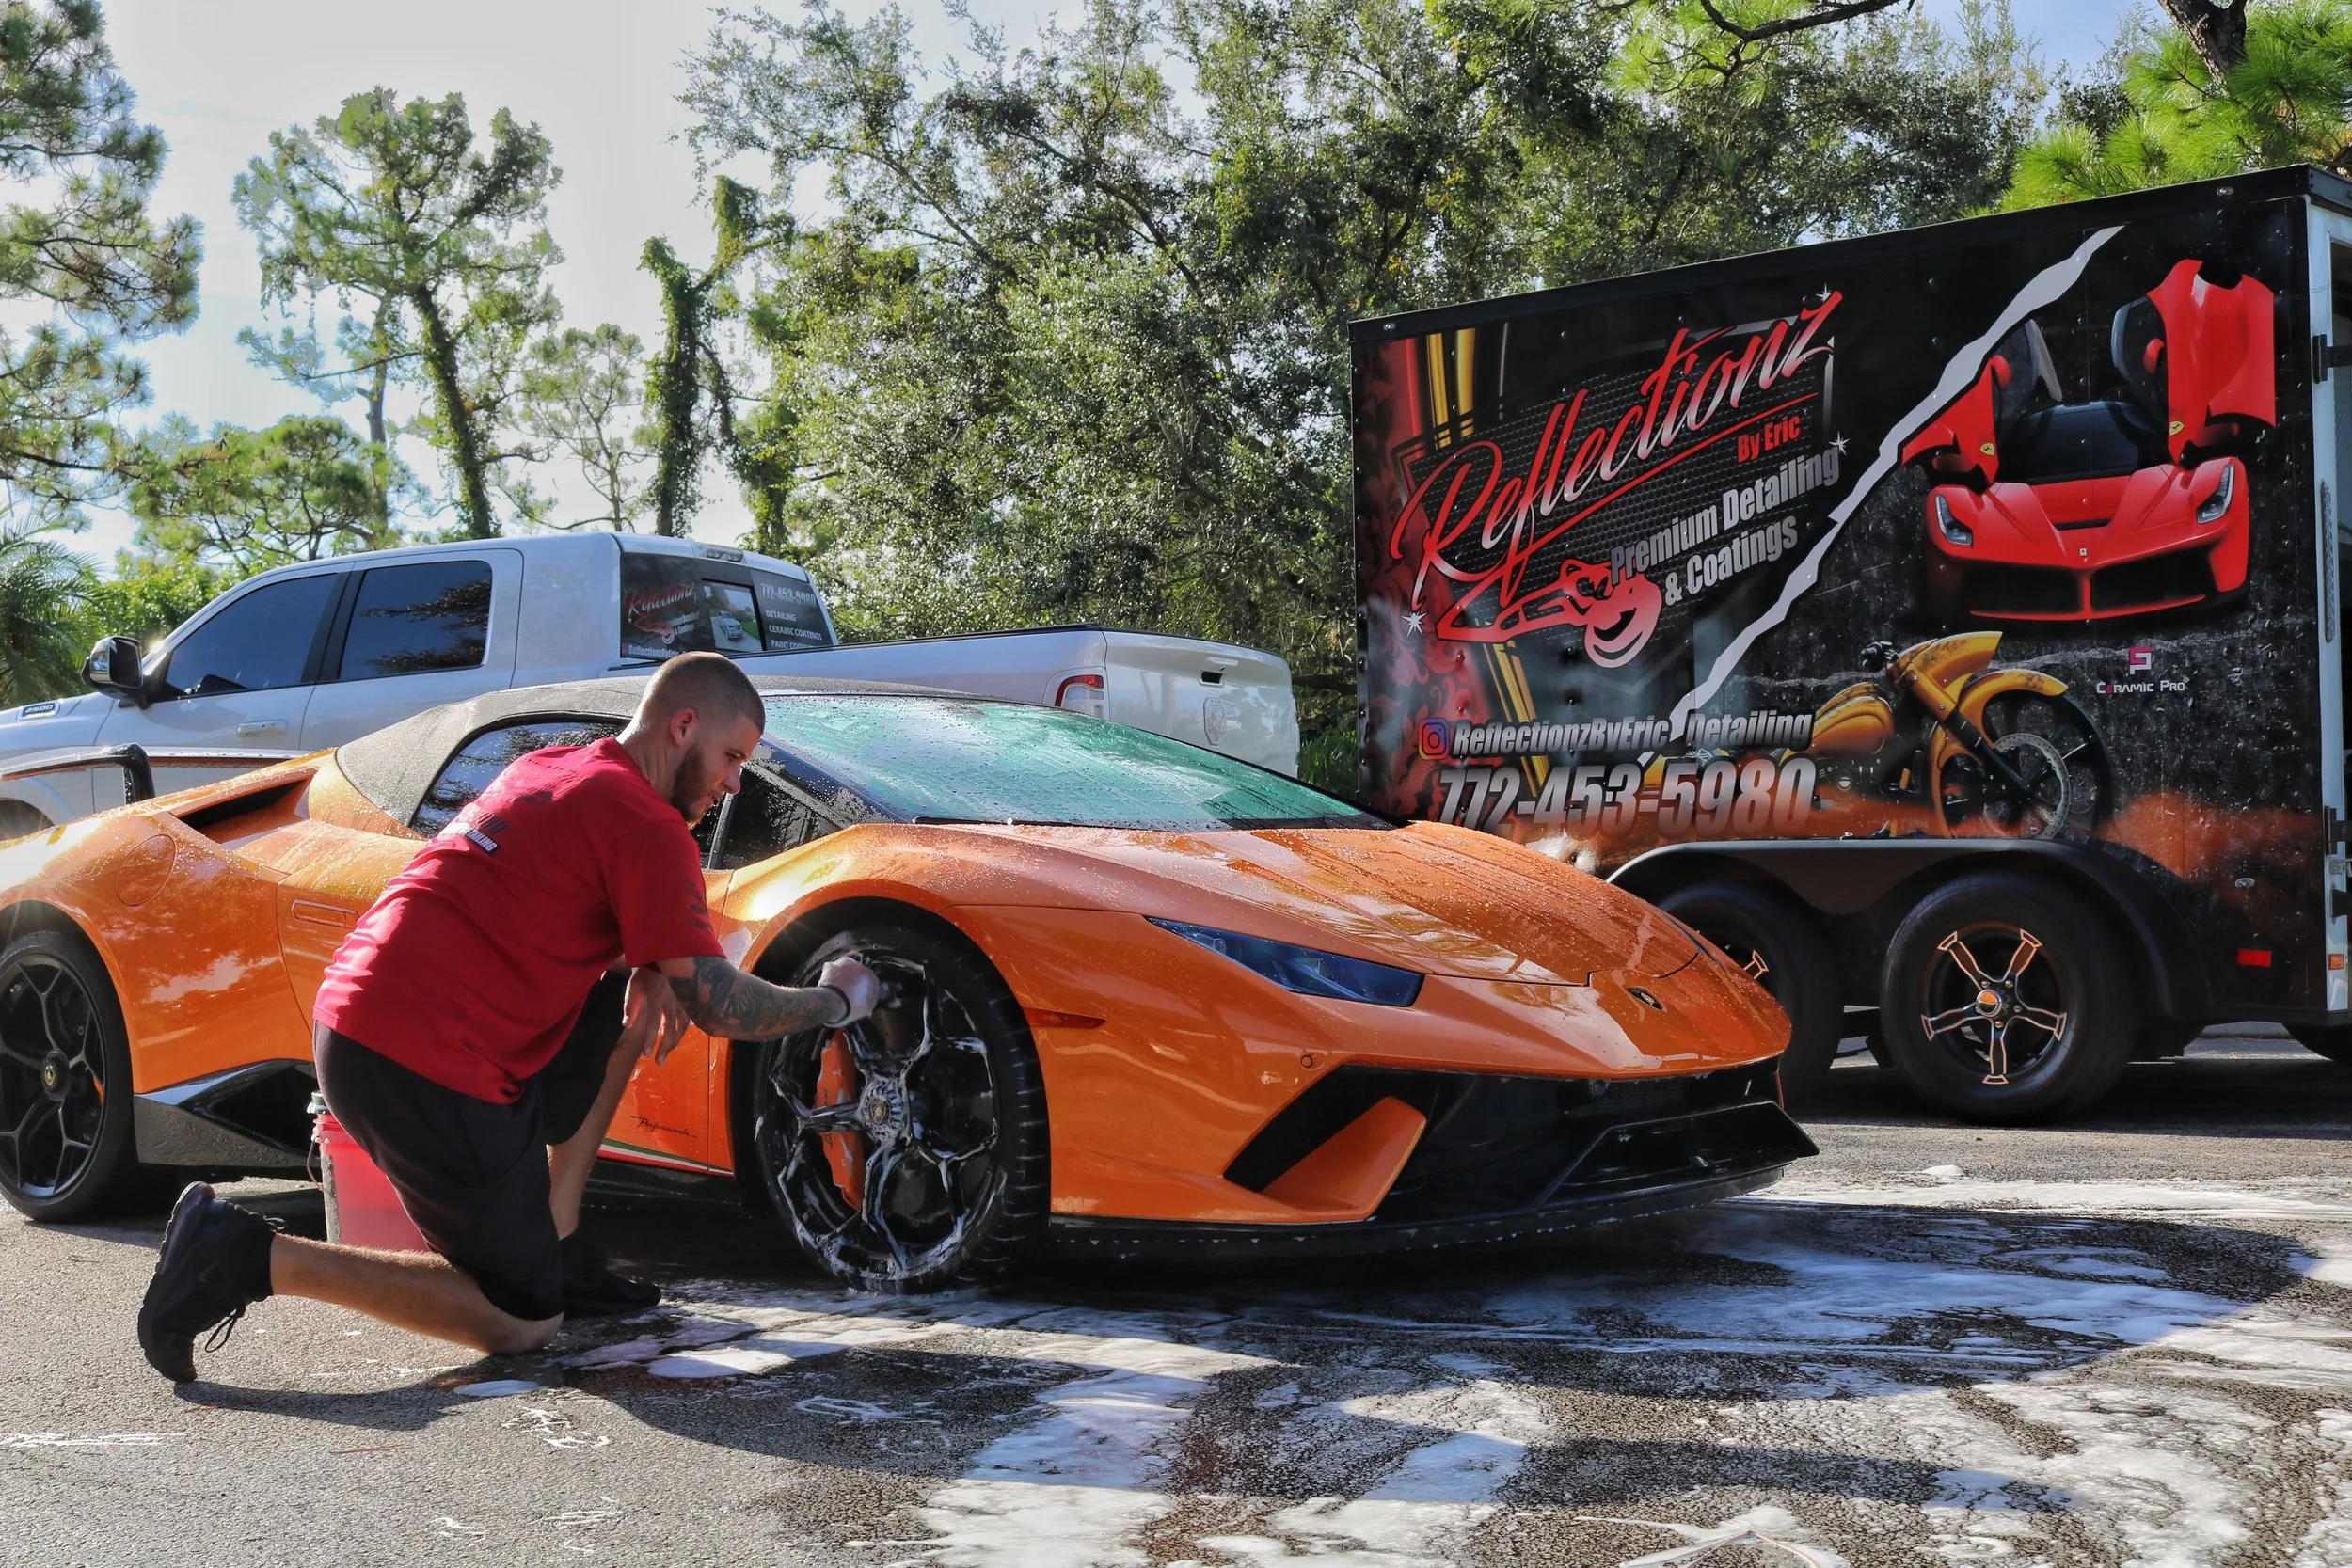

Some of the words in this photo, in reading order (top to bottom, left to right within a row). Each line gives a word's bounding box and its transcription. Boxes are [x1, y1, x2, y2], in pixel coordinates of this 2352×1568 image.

[1391, 290, 1843, 610] Reflectionz
[1737, 432, 1760, 463] By
[1764, 416, 1801, 451] Eric
[1610, 504, 1718, 586] Premium
[1722, 445, 1840, 531] Detailing
[1665, 571, 1683, 606] &
[1686, 515, 1798, 594] Coatings
[765, 610, 797, 622] DETAILING
[769, 625, 794, 636] CERAMIC
[795, 628, 823, 641] COATINGS
[771, 640, 788, 649] PAINT
[1453, 715, 1669, 755] ReflectionzByEric
[1686, 710, 1812, 747] Detailing
[1438, 757, 1817, 838] 772-453-5980
